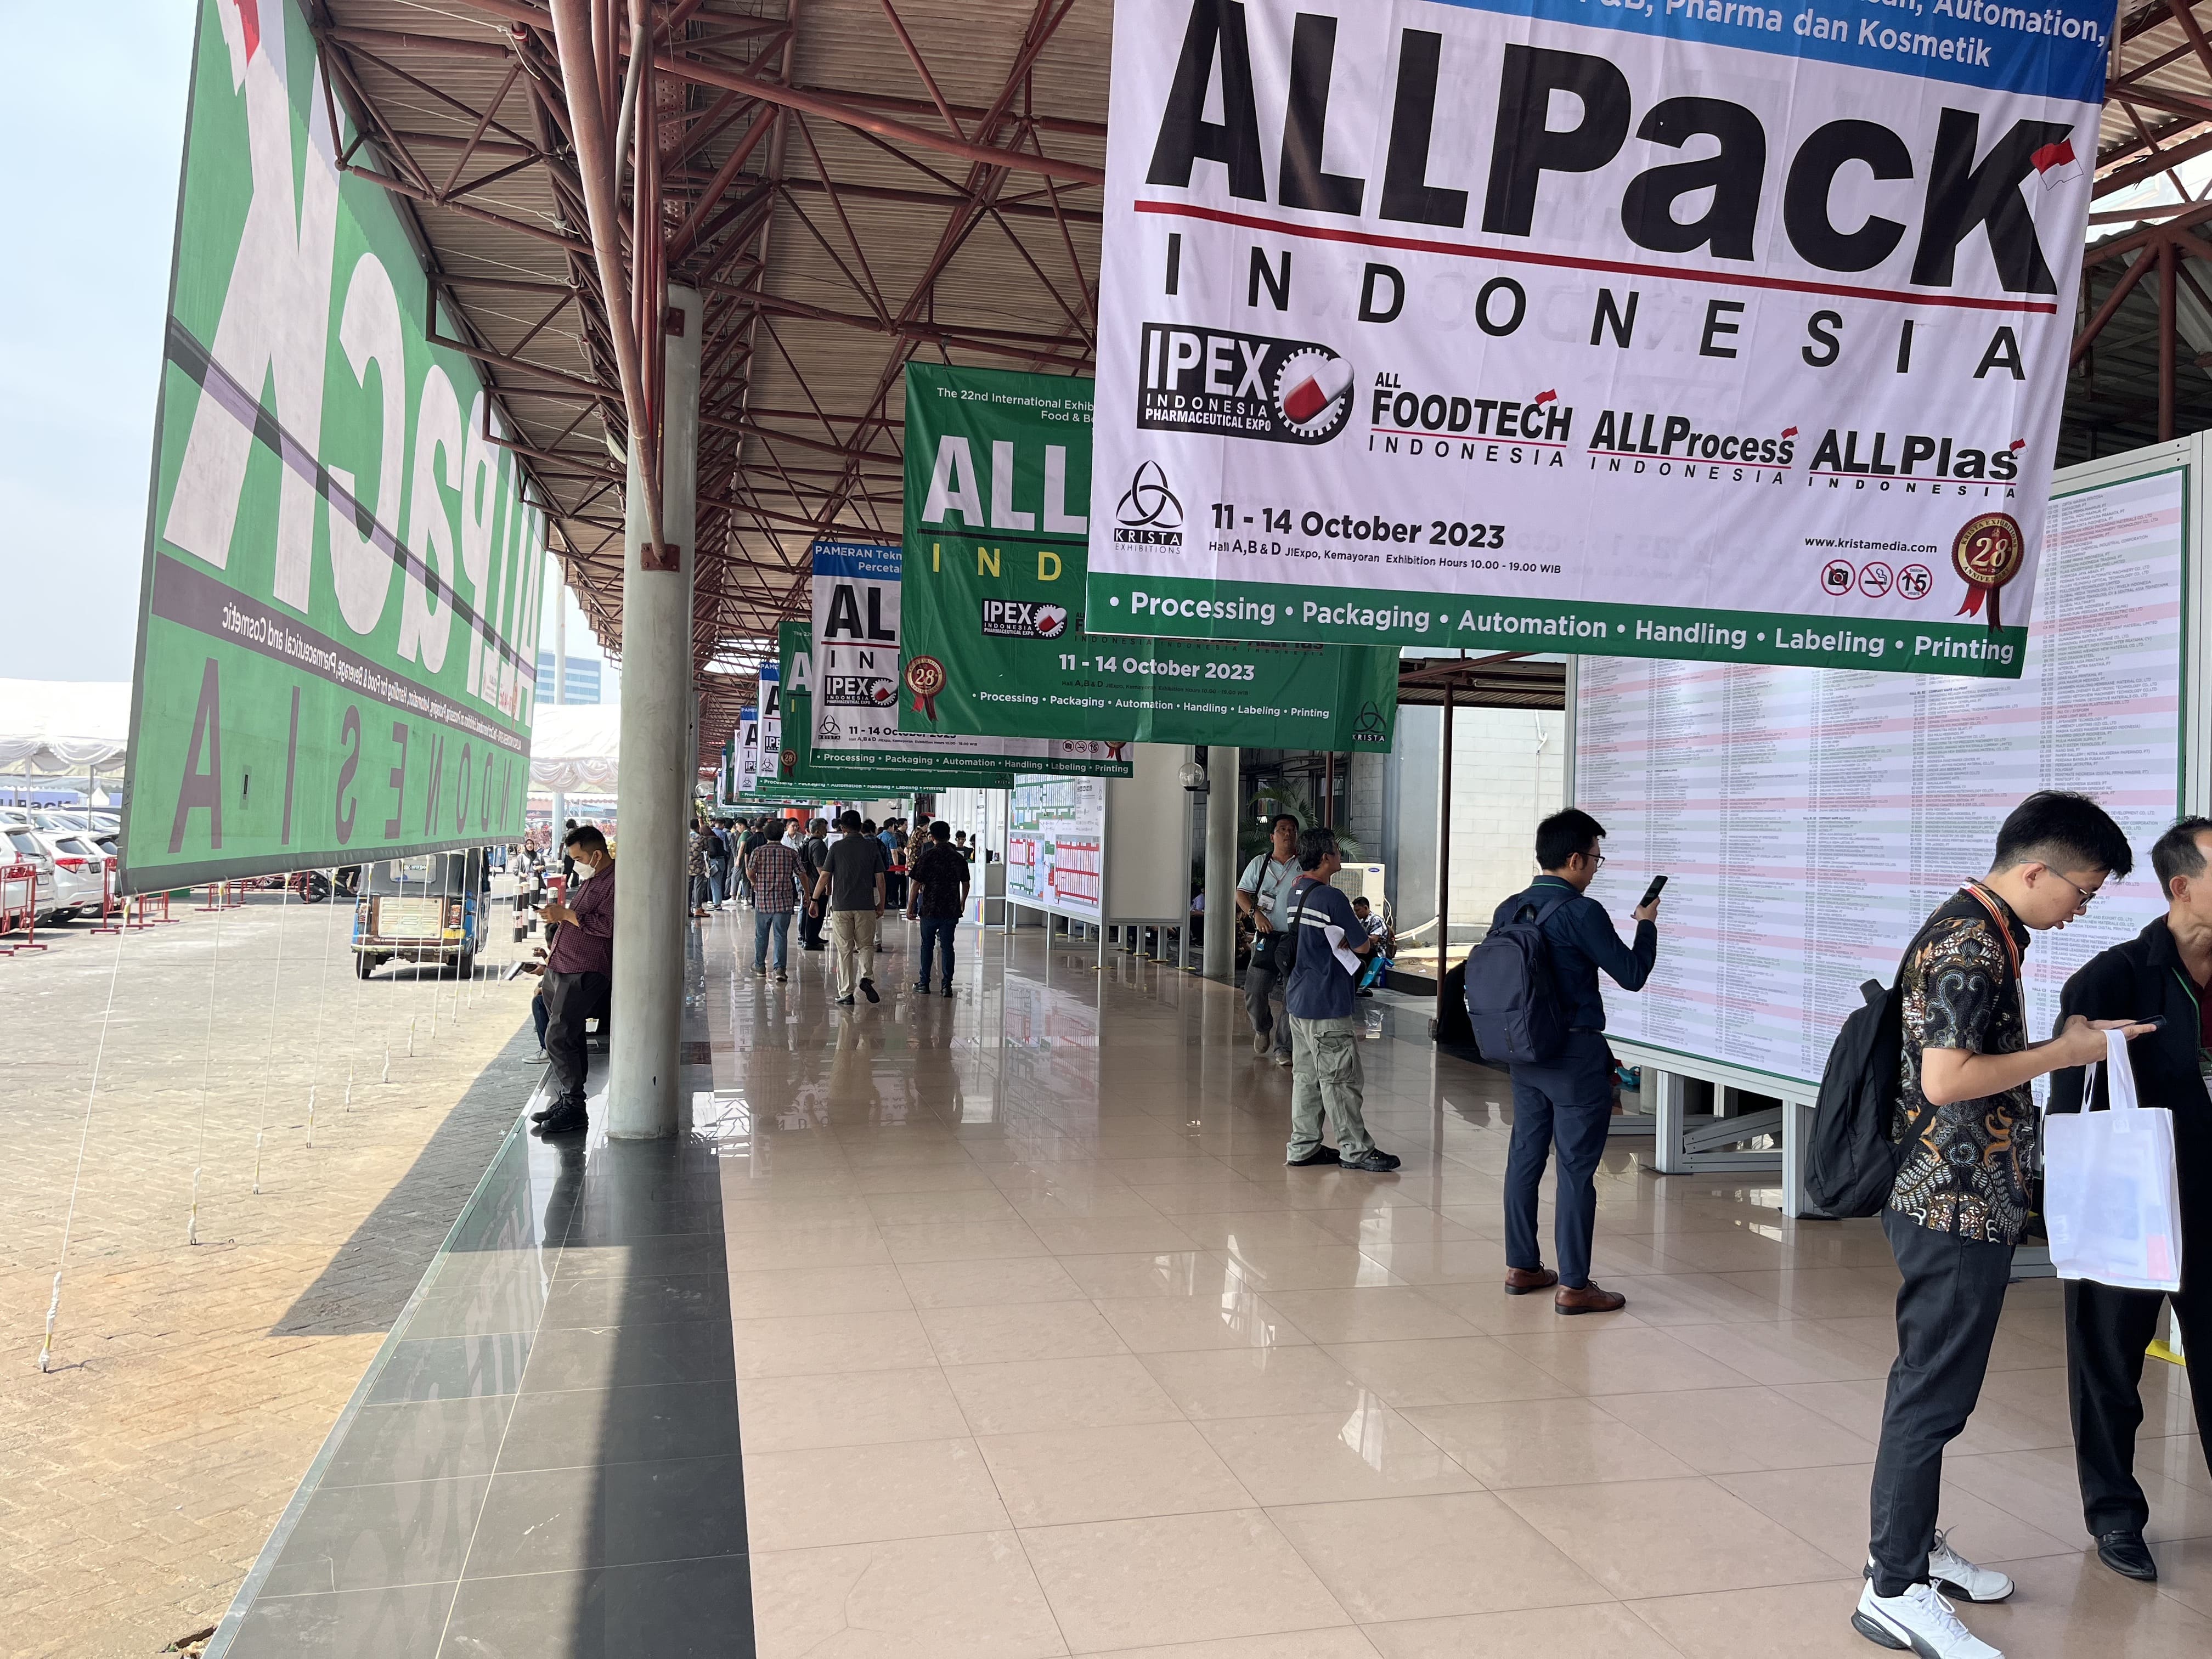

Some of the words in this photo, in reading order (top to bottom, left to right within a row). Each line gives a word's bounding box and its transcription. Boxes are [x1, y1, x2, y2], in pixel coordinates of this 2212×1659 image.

[1932, 0, 2106, 48] Automation,
[1793, 9, 1848, 42] dan
[1858, 19, 1992, 67] Kosmetik
[1165, 233, 2026, 381] INDONESIA
[1147, 330, 1271, 402] IPEX
[1375, 371, 1401, 389] ALL
[936, 387, 958, 400] The
[961, 388, 989, 402] 22nd
[992, 393, 1062, 409] International
[1146, 393, 1268, 418] INDONESIA
[1041, 410, 1069, 421] Food
[1072, 413, 1080, 422] &
[1145, 408, 1244, 431] PHARMACEUTICAL
[1245, 416, 1272, 432] EXPO
[1372, 389, 1573, 442] FOODTECH
[1588, 410, 1795, 465] ALLProcess
[1369, 435, 1564, 467] INDONESIA
[1809, 428, 2019, 481] ALLPlas
[1590, 456, 1783, 484] INDONESIA
[921, 434, 1088, 534] ALL
[1808, 477, 2016, 498] INDONESIA
[1115, 529, 1181, 545] KRISTA
[1211, 503, 1234, 530] 11
[1262, 507, 1293, 534] 14
[1301, 511, 1422, 544] October
[1429, 520, 1505, 549] 2023
[1961, 522, 1984, 545] KRISTA
[1985, 520, 2018, 548] EXHIBITIONS
[815, 545, 873, 559] PAMERAN
[1115, 543, 1181, 555] EXHIBITIONS
[1209, 541, 1229, 551] Hall
[1232, 539, 1257, 556] A,B
[1260, 544, 1268, 555] &
[1271, 542, 1281, 555] D
[1324, 550, 1380, 562] Kemayoran
[1386, 554, 1436, 566] Exhibition
[1440, 557, 1468, 568] Hours
[1471, 560, 1499, 570] 10.00
[1509, 561, 1537, 572] 19.00
[1540, 564, 1561, 574] WIB
[1804, 537, 1938, 554] www.kristamedia.com
[1970, 537, 2008, 567] 28
[932, 543, 1063, 581] IND
[1901, 573, 1927, 591] 15
[823, 584, 895, 641] AL
[984, 600, 1032, 625] IPEX
[984, 622, 1032, 631] INDONESIA
[1131, 591, 1276, 625] Processing
[1302, 601, 1430, 634] Packaging
[1458, 609, 1607, 638] Automation
[1635, 619, 1747, 650] Handling
[1775, 628, 1886, 657] Labeling
[1914, 636, 2015, 663] Printing
[1075, 635, 1152, 646] INDONESIA
[1161, 641, 1238, 652] INDONESIA
[915, 668, 935, 686] 28
[1059, 654, 1075, 670] 11
[1095, 656, 1117, 673] 14
[1122, 657, 1200, 678] October
[1205, 662, 1255, 681] 2023
[826, 676, 870, 696] IPEX
[980, 691, 1039, 705] Processing
[1049, 695, 1105, 709] Packaging
[1115, 697, 1173, 710] Automation
[1183, 702, 1227, 714] Handling
[1238, 704, 1280, 717] Labeling
[1290, 707, 1329, 719] Printing
[849, 726, 857, 735] 11
[868, 726, 880, 735] 14
[1352, 733, 1386, 742] KRISTA
[824, 754, 875, 763] Processing
[885, 755, 933, 765] Packaging
[943, 758, 996, 768] Automation
[1005, 760, 1043, 770] Handling
[1051, 763, 1086, 772] Labeling
[1095, 764, 1128, 774] Printing
